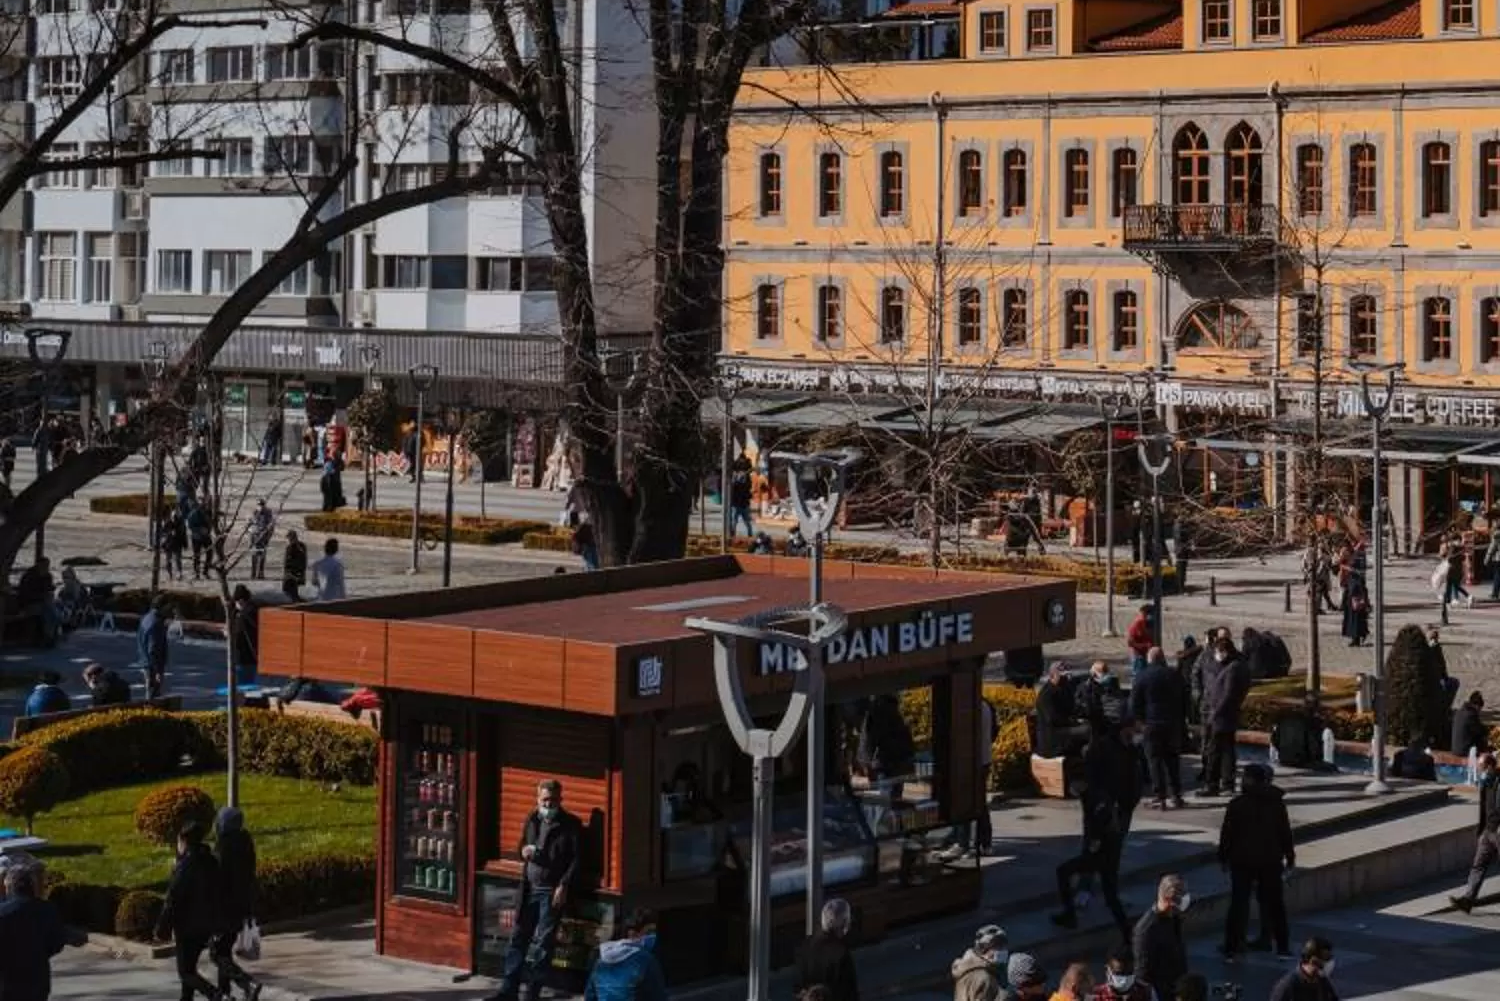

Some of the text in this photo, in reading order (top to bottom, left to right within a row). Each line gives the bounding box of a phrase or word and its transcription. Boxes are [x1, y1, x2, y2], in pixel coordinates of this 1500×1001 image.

[1184, 390, 1221, 407] PARK
[1224, 391, 1265, 408] OTEL
[1426, 395, 1497, 417] COFFEE
[761, 611, 973, 676] MDAN BÜFE
